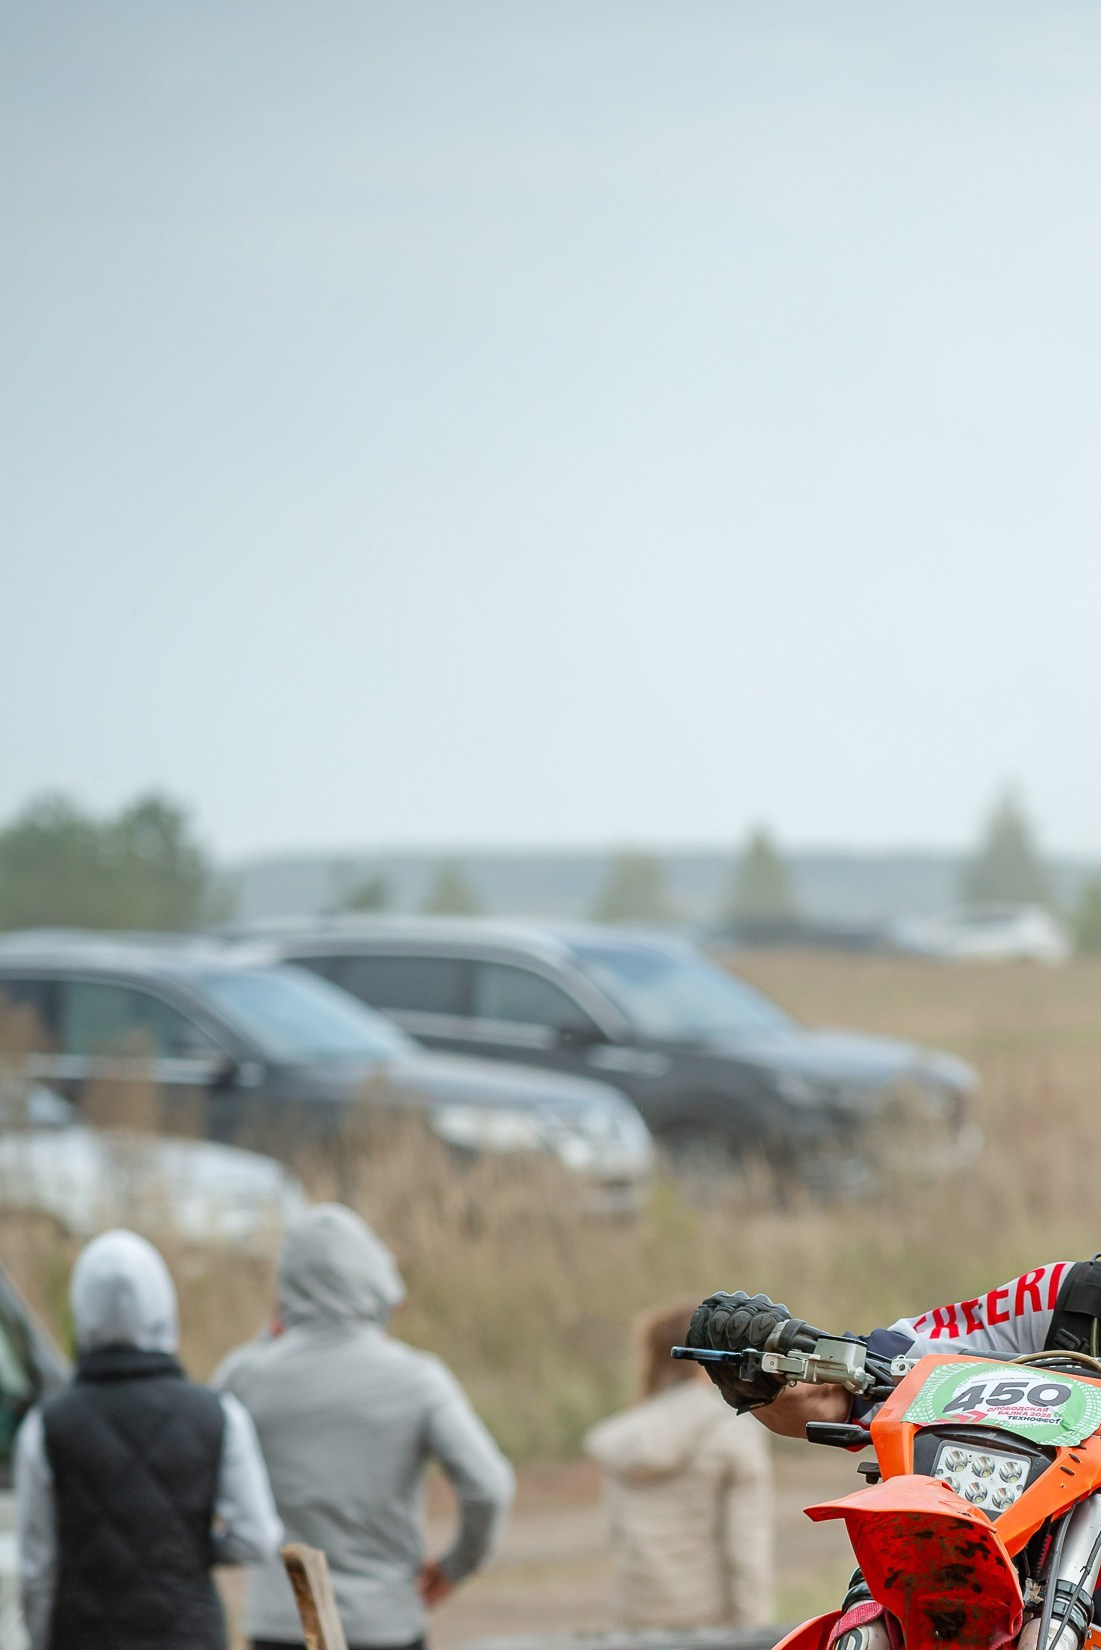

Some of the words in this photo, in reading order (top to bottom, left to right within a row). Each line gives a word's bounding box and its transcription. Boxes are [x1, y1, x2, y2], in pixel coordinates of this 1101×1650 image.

[941, 1381, 1072, 1413] 450
[987, 1405, 1049, 1413] СЛОБОДСКАЯ
[1007, 1414, 1061, 1425] ТЕХНОФЕСТ
